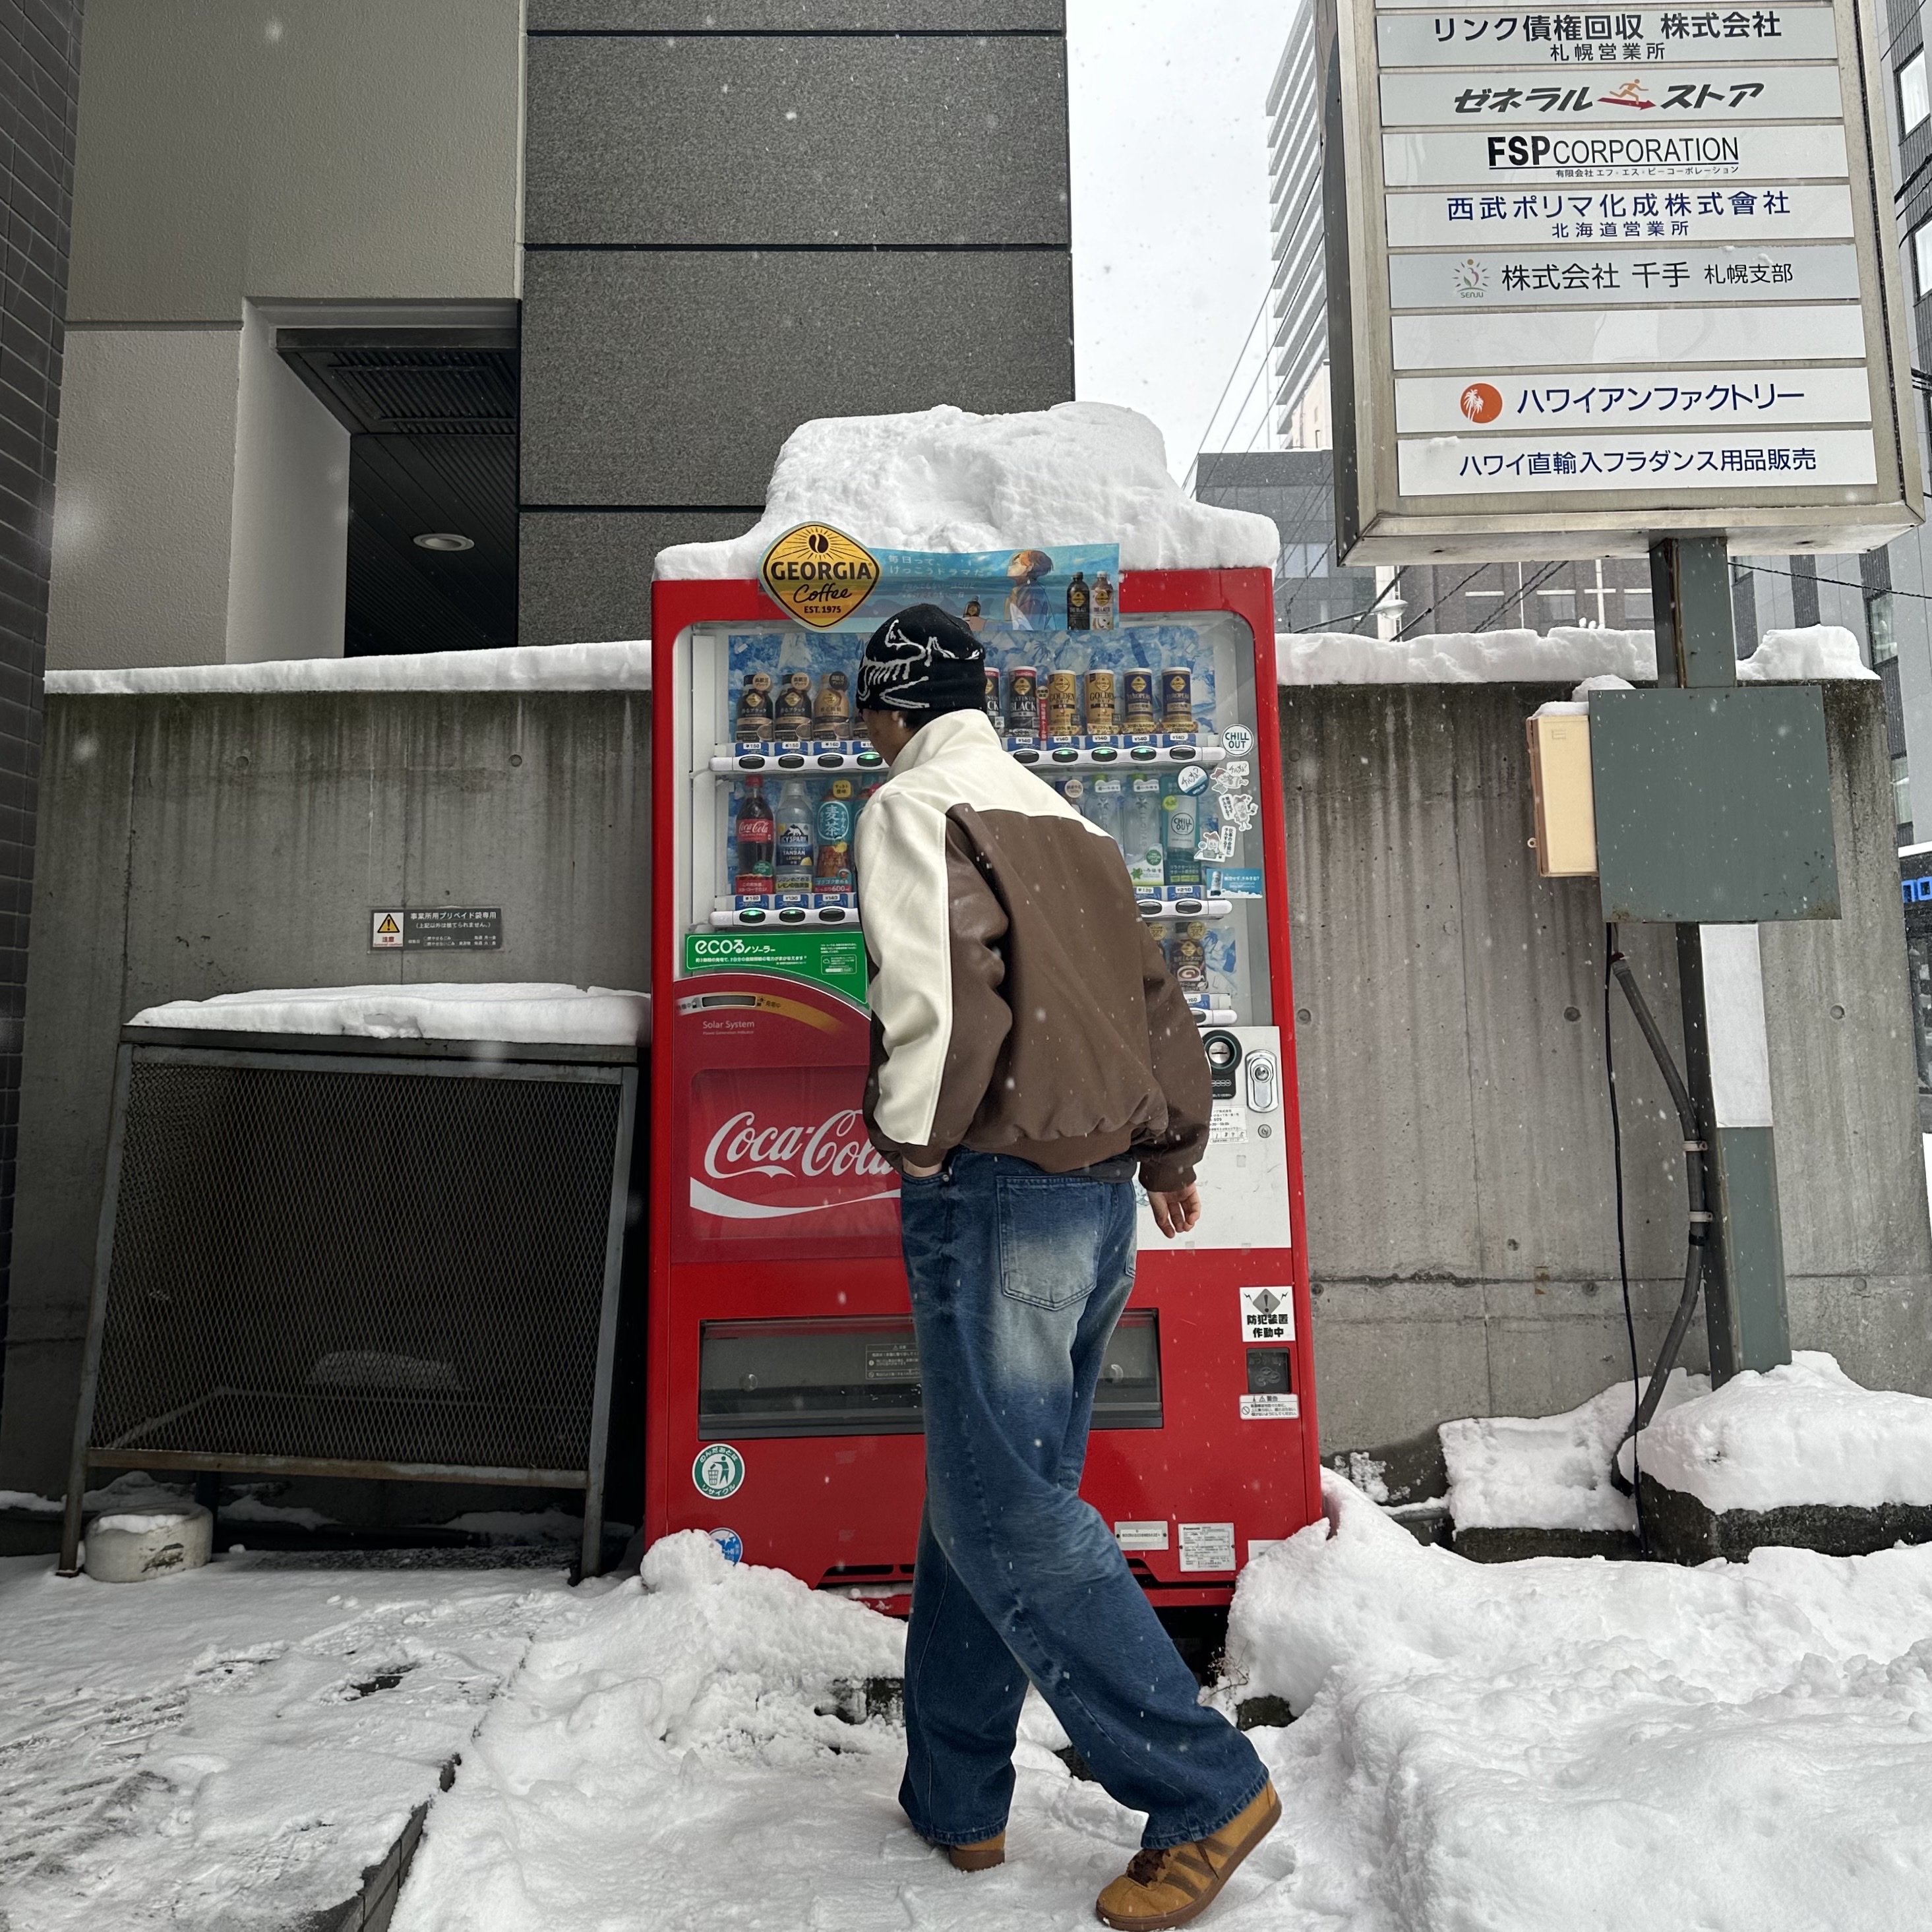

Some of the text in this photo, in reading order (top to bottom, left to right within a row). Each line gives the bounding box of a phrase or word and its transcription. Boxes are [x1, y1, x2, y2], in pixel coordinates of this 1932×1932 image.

[1434, 11, 1782, 42] リンク債権回収 株式会社
[1550, 42, 1666, 61] 札幌営業所
[1453, 82, 1765, 113] ゼネラル ストア
[1555, 168, 1594, 178] 有限会社
[1447, 190, 1791, 222] 西武ポリマ化成株式會社
[1551, 220, 1689, 239] 北海道営業所
[1501, 261, 1794, 291] 株式会社 千手 札幌支部
[1517, 382, 1805, 414] ハワイアンファクトリー
[1459, 448, 1817, 477] ハワイ直輸入フラダンス用品販売
[888, 555, 942, 566] 毎日って、
[770, 561, 872, 581] GEORGIA
[890, 566, 992, 577] けっこうドラマだ。
[793, 582, 853, 603] Coffee
[804, 605, 841, 614] EST. 1975
[1010, 702, 1037, 711] BLACK
[1224, 732, 1250, 740] CHILL
[1228, 740, 1246, 749] OUT
[825, 804, 841, 837] 麦茶
[725, 1021, 754, 1030] System
[1247, 1314, 1288, 1325] 防犯装置
[1253, 1328, 1284, 1338] 作動中
[700, 1447, 739, 1463] のんだあとは
[702, 1484, 736, 1496] リサイクル
